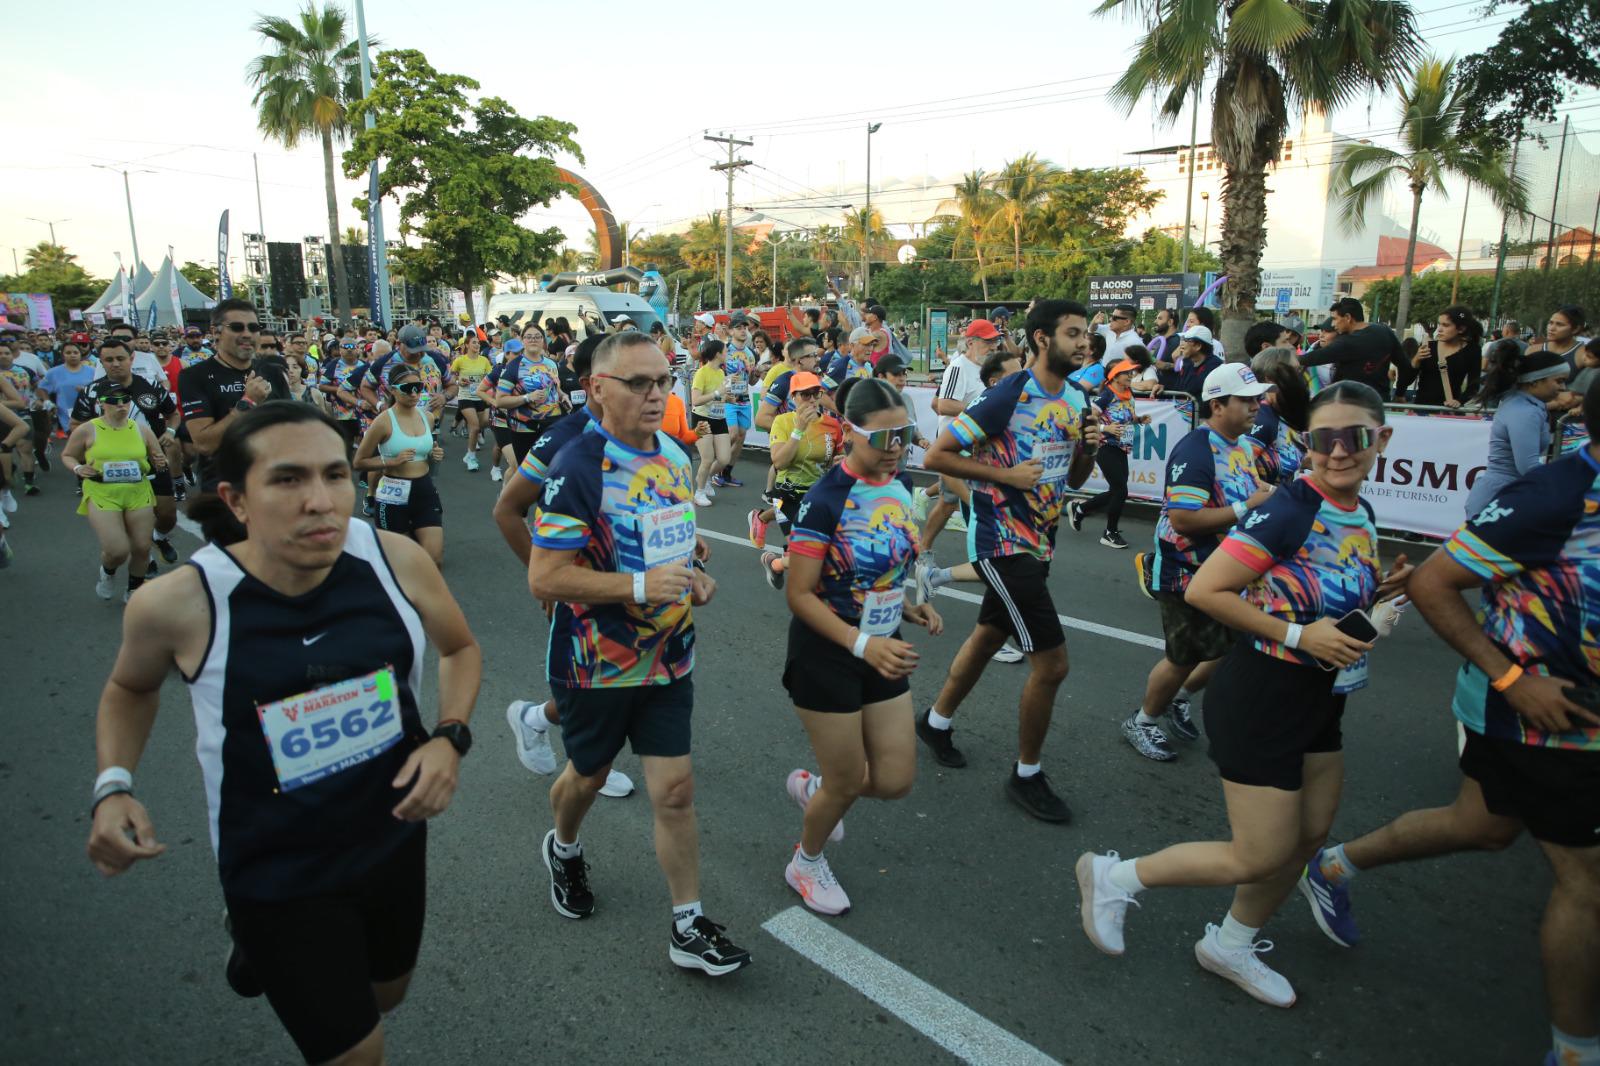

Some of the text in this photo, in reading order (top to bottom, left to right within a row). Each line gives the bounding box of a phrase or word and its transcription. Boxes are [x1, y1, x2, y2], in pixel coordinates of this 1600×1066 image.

[370, 216, 378, 274] CERRITOS
[1090, 281, 1100, 289] EL
[1102, 280, 1134, 289] ACOSO
[1294, 285, 1312, 296] DÍAZ
[1377, 488, 1392, 497] DE
[1394, 489, 1448, 504] TURISMO
[647, 520, 694, 548] 4539
[280, 700, 394, 758] 6562
